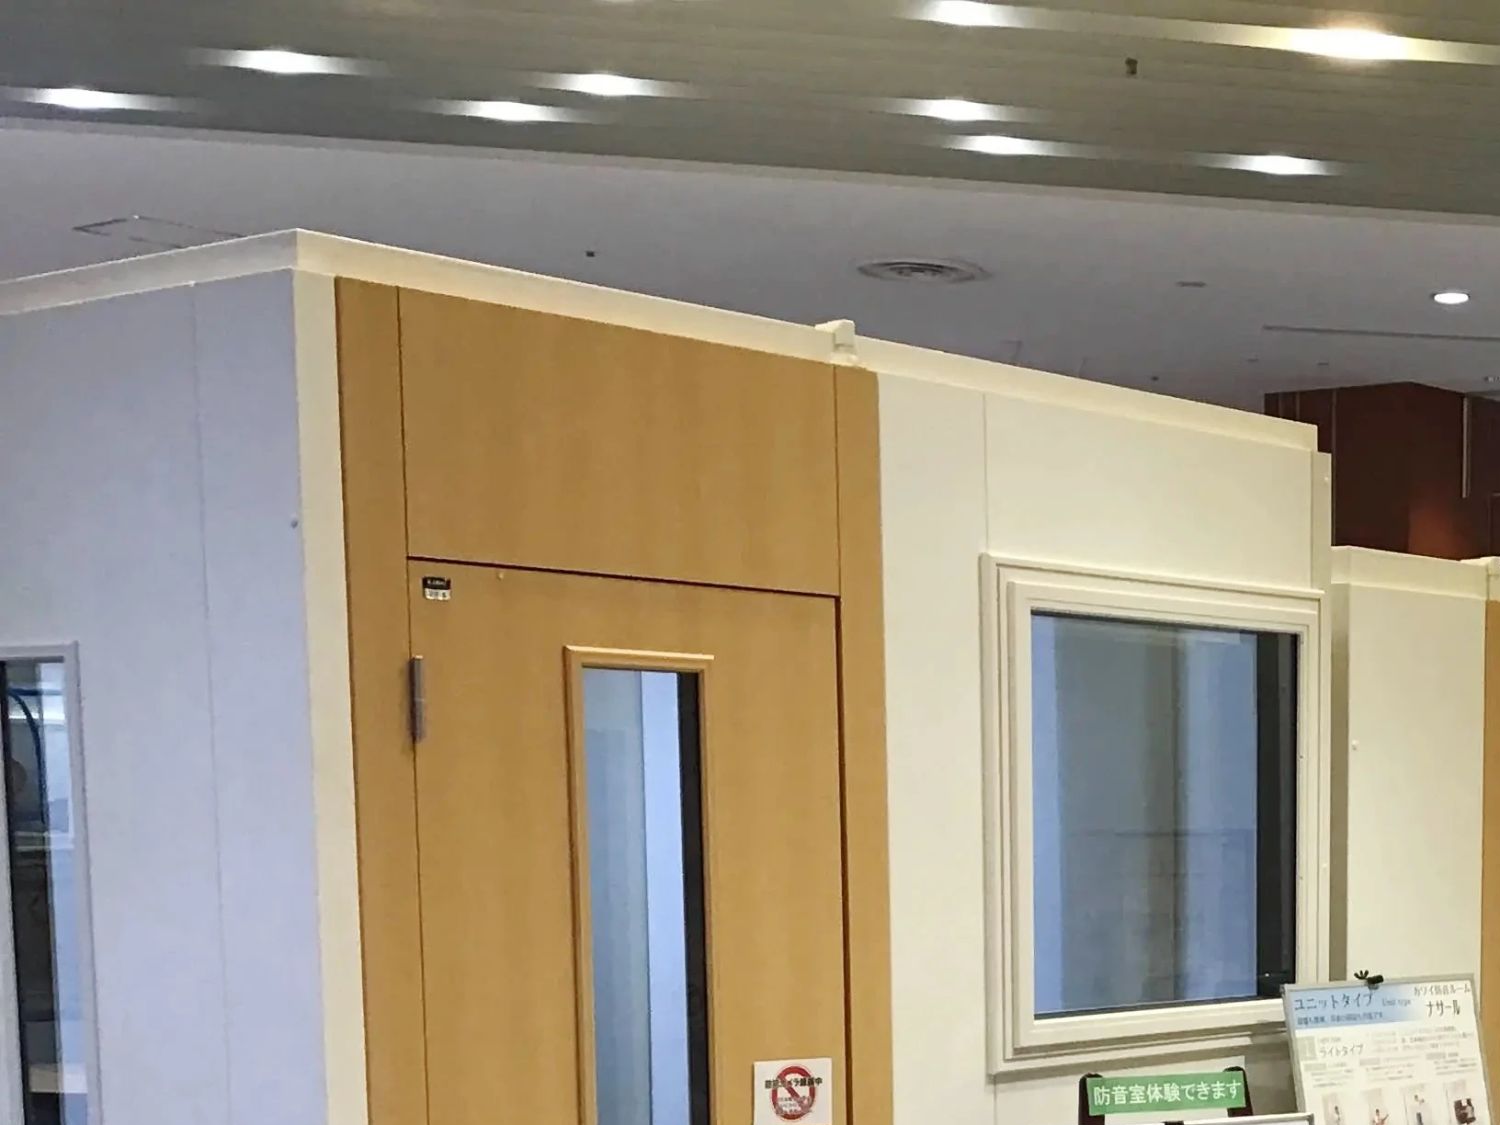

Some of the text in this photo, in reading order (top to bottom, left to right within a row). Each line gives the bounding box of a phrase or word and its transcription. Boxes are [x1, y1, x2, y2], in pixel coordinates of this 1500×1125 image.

[1294, 992, 1374, 1011] ユニットタイプ
[1425, 999, 1461, 1017] ナサール
[1319, 1044, 1364, 1058] ライトタイプ
[1093, 1080, 1242, 1106] 防音室体験できます
